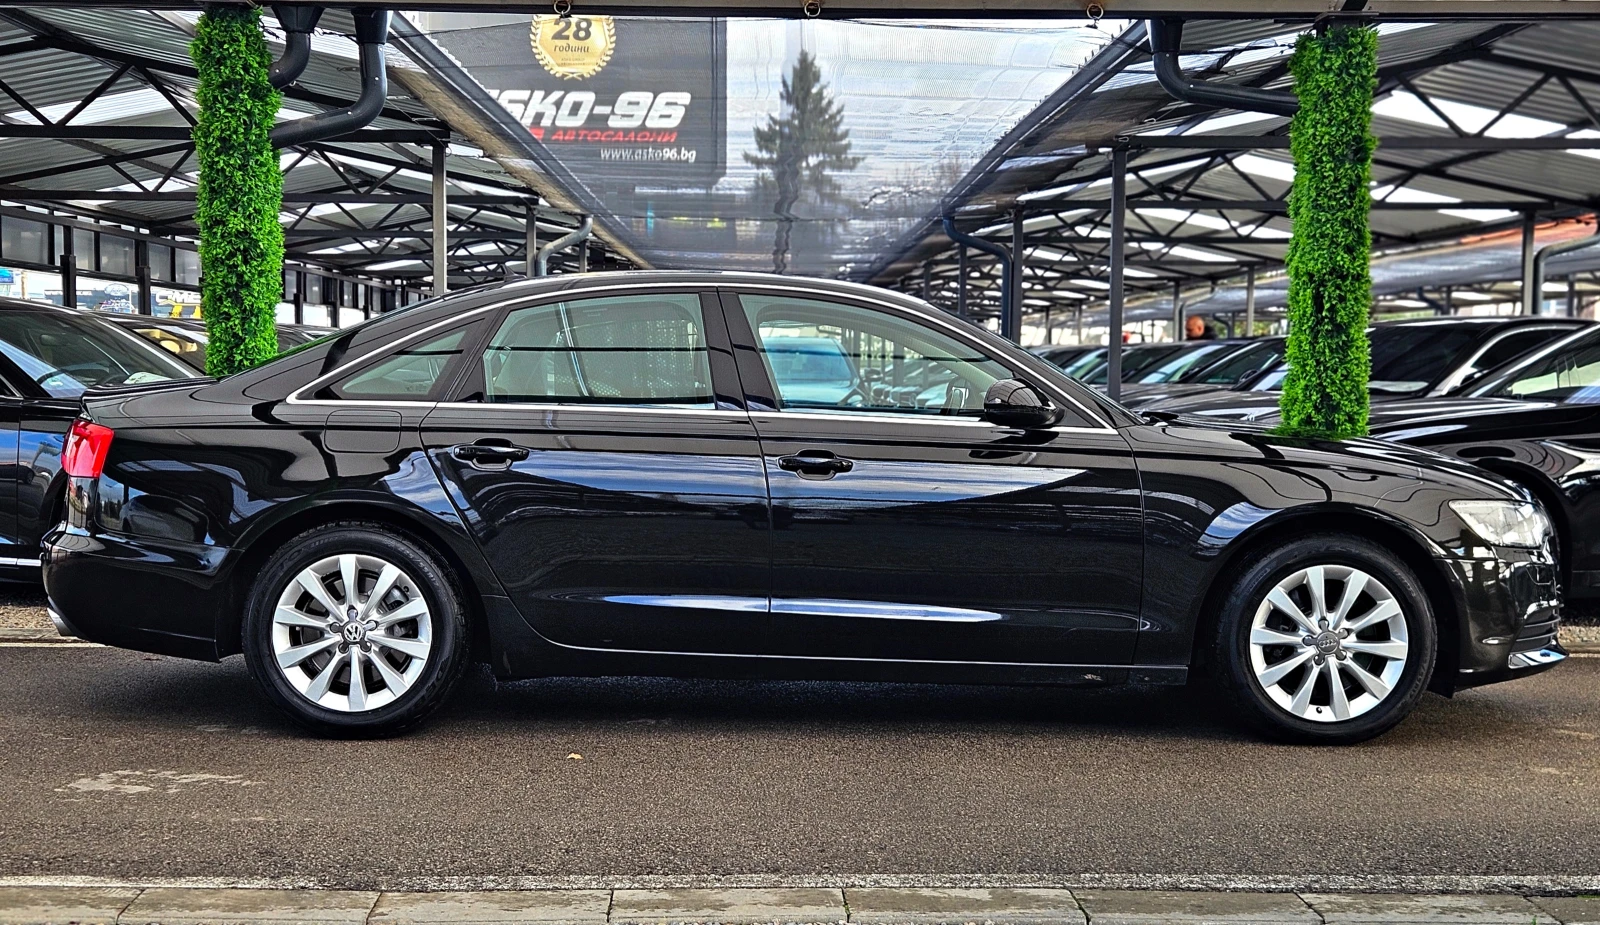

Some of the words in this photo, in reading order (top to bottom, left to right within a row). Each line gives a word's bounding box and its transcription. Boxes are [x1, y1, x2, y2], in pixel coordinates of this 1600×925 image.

[551, 18, 592, 41] 28
[553, 43, 590, 53] години
[491, 89, 692, 129] SKO-96
[551, 129, 678, 143] АВТОСАЛОНИ
[600, 147, 697, 164] www.asko96.bg
